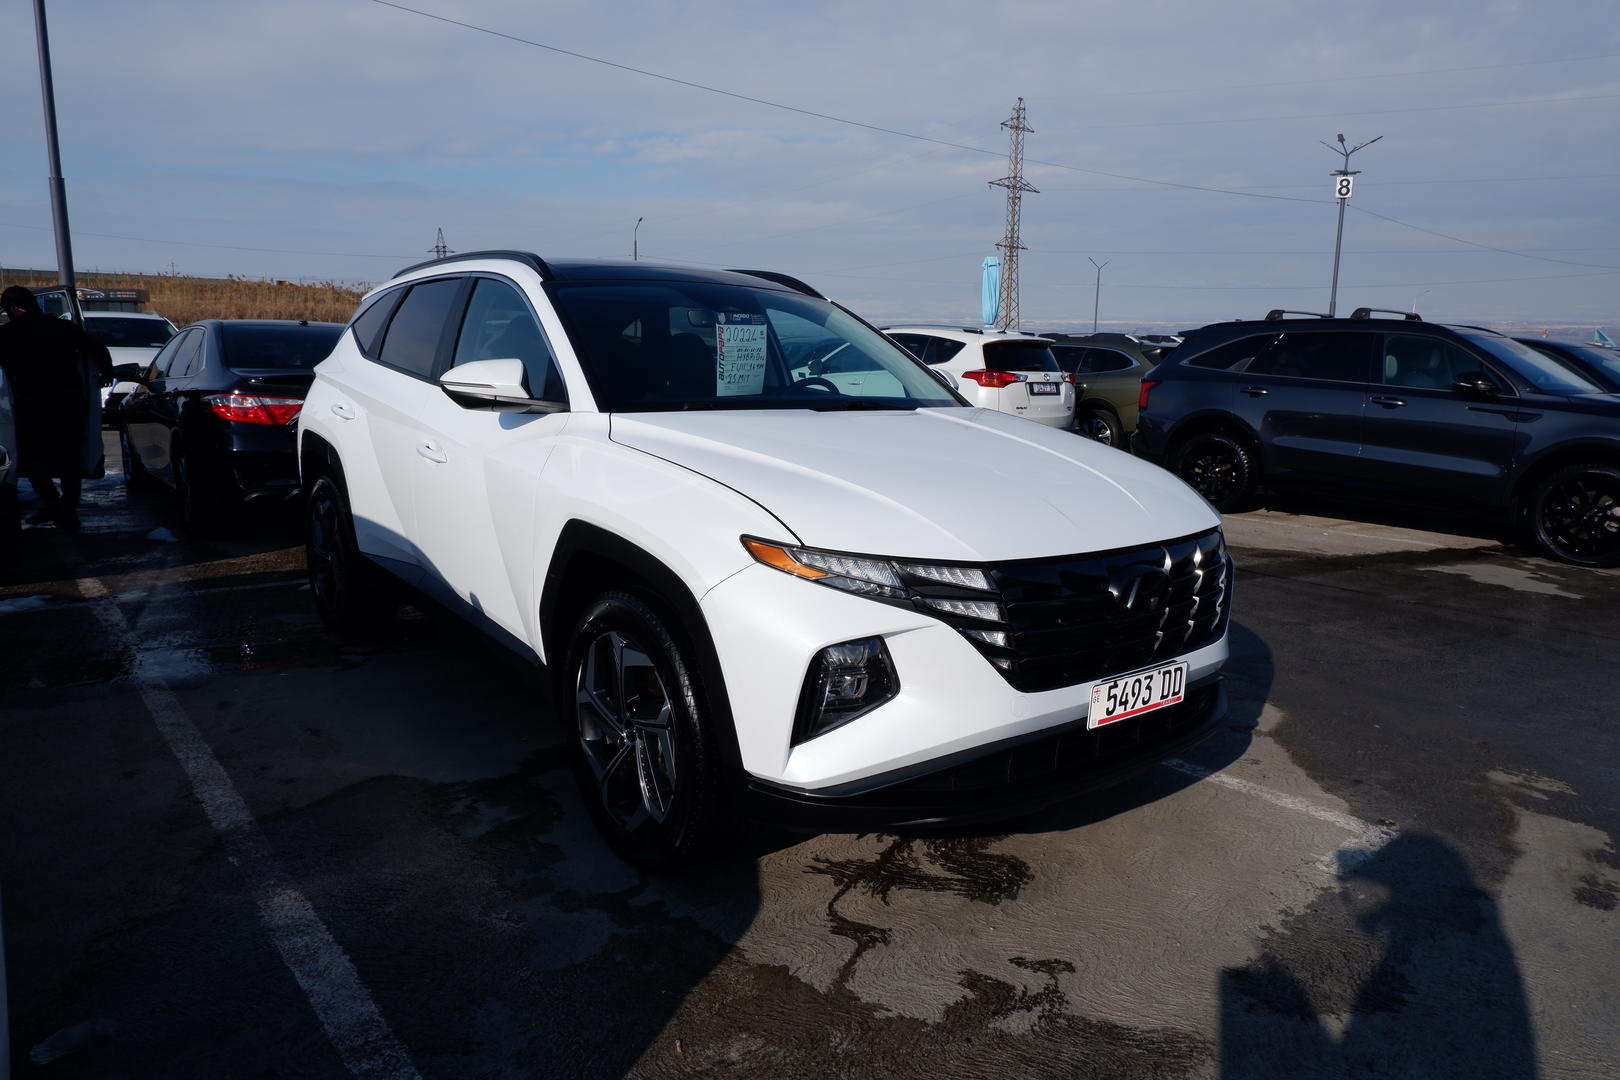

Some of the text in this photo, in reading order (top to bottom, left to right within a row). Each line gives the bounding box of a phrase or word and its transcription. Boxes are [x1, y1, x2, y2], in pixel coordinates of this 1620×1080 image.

[1338, 179, 1350, 196] 8
[1106, 667, 1182, 716] 5493 DD
